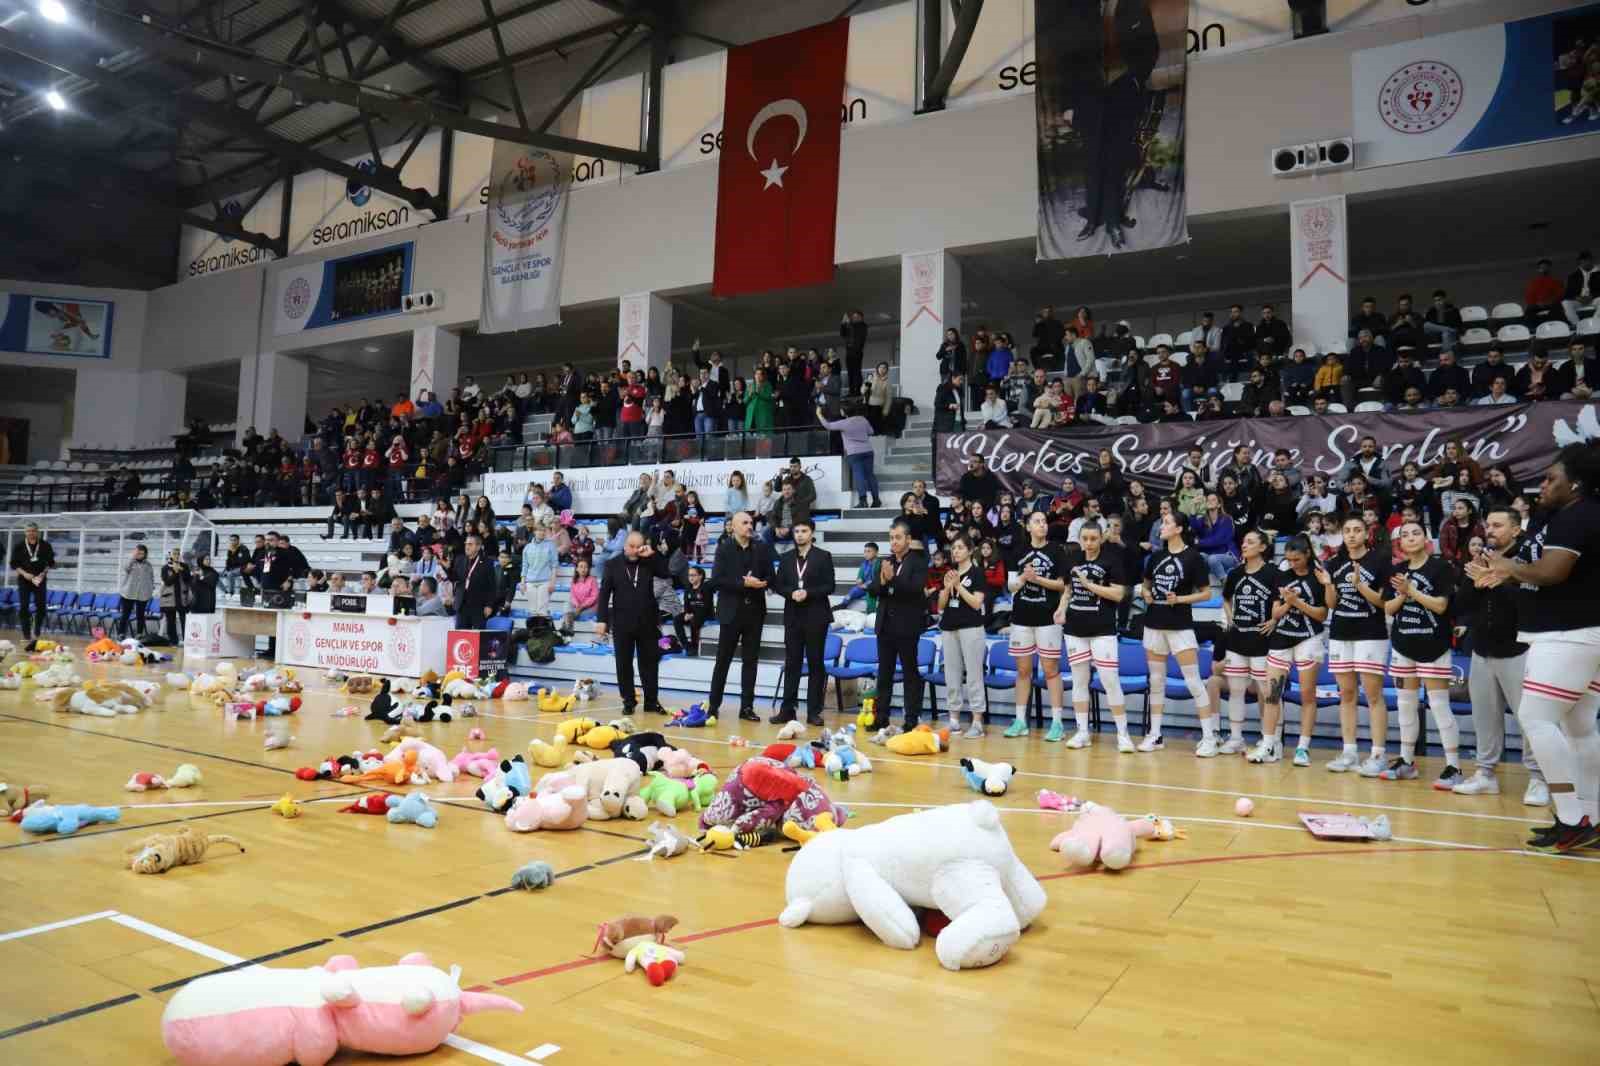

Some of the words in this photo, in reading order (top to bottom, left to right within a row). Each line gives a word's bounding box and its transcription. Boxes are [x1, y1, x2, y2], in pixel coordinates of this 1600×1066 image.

[312, 206, 409, 246] seramiksan
[189, 246, 267, 277] seramiksan
[332, 622, 365, 634] MANİSA
[315, 638, 348, 651] GENÇLİK
[349, 639, 360, 650] VE
[361, 640, 384, 652] SPOR
[326, 654, 378, 670] MÜDÜRLÜĞÜ
